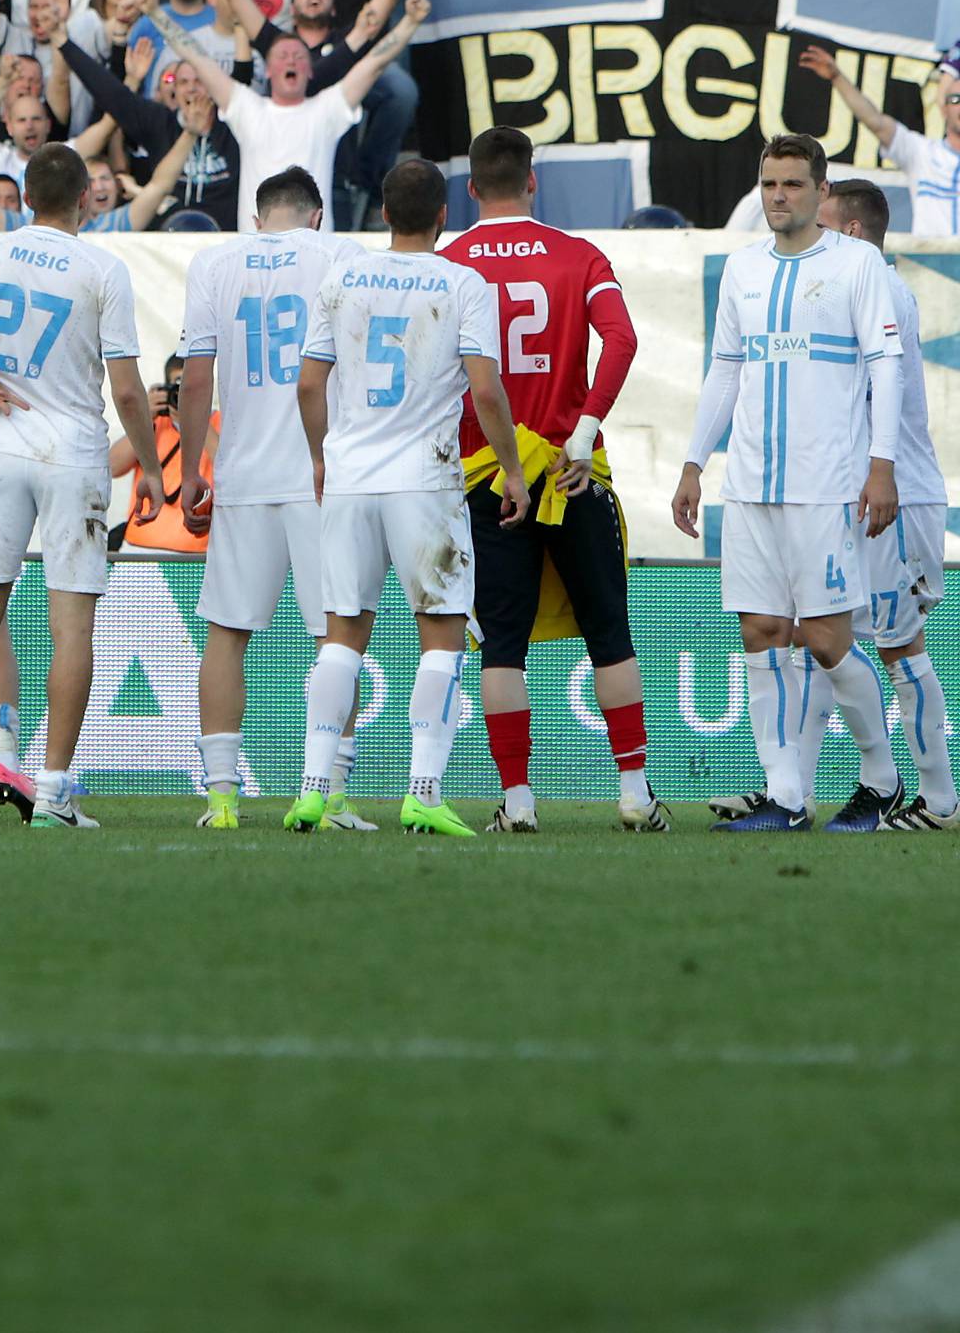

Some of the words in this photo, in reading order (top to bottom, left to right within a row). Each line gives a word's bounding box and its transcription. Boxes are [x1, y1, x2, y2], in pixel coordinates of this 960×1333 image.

[9, 246, 71, 273] MIŠIĆ
[246, 251, 297, 271] ELEZ
[468, 240, 548, 259] SLUGA
[342, 270, 449, 293] ČANADIJA
[235, 294, 308, 387] 18
[774, 338, 808, 351] SAVA
[365, 315, 411, 408] 5
[826, 554, 846, 592] 4
[314, 723, 341, 735] JAKO
